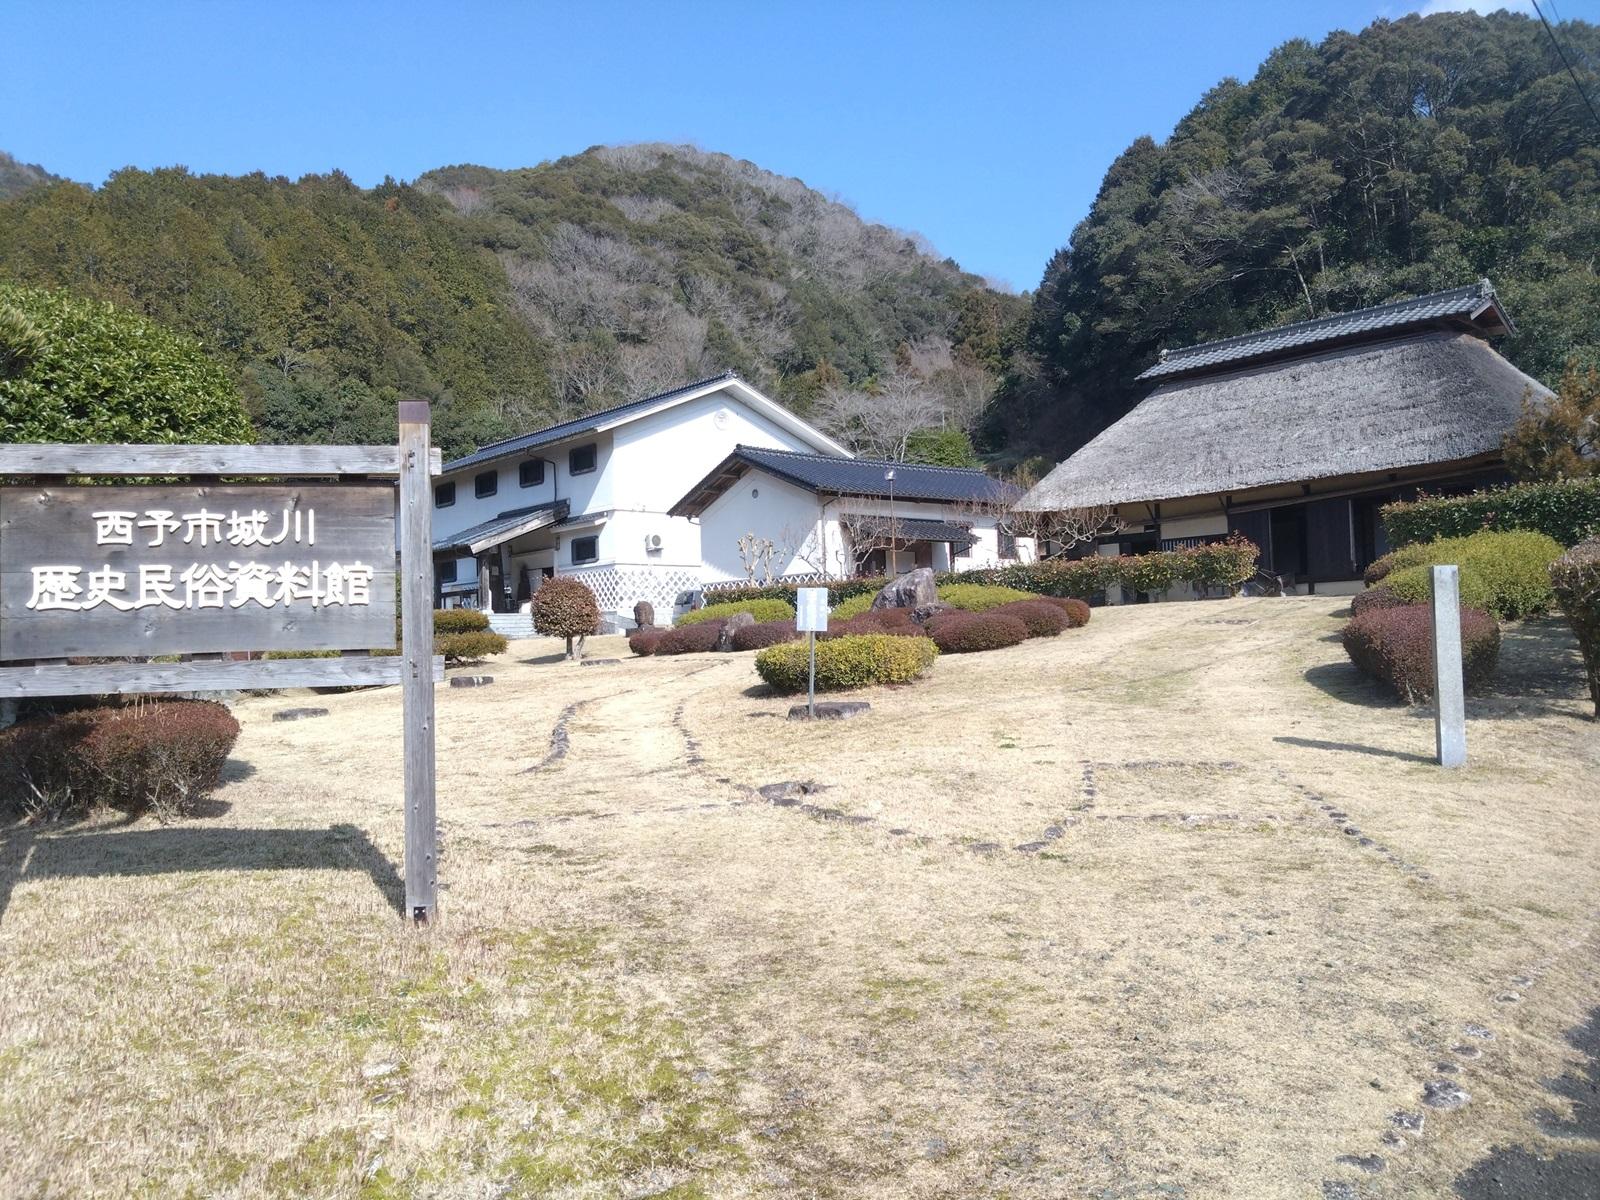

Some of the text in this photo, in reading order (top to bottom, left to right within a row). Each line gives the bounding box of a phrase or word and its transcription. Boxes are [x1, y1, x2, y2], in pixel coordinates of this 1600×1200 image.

[92, 508, 315, 547] 西予市城川
[26, 560, 374, 611] 歴史民俗資料館
